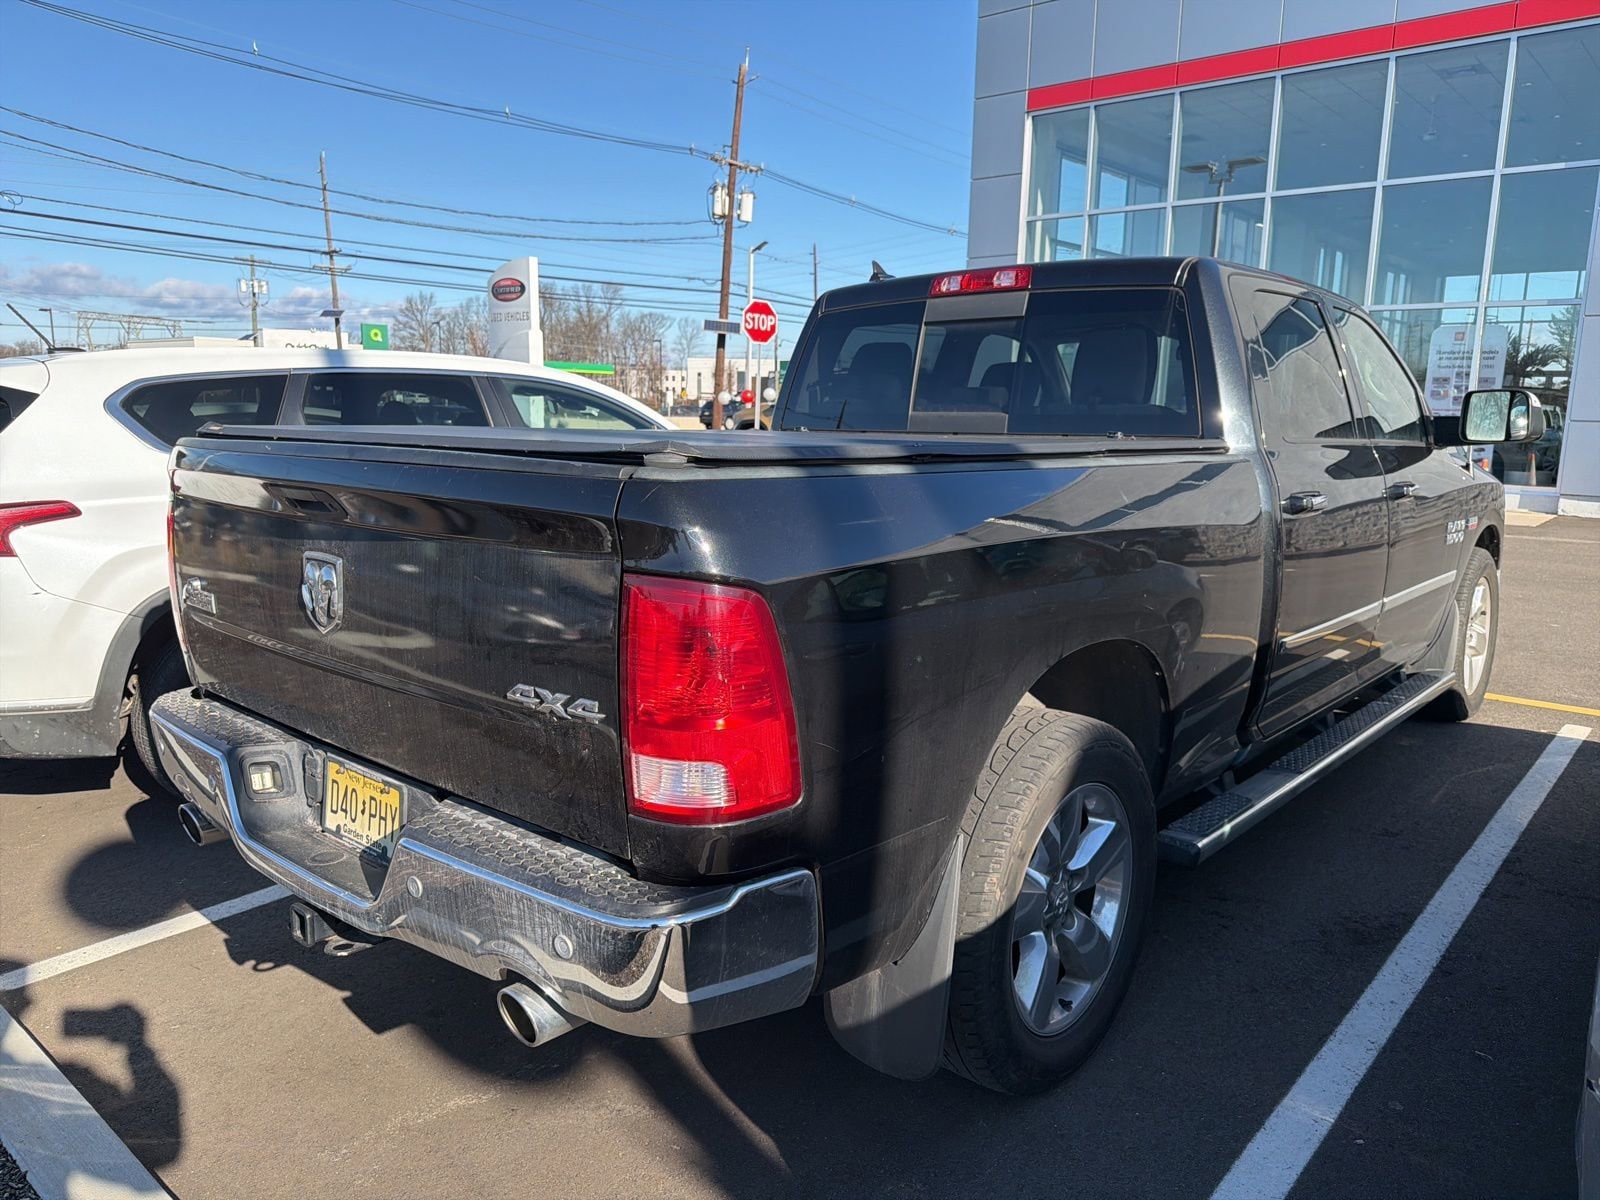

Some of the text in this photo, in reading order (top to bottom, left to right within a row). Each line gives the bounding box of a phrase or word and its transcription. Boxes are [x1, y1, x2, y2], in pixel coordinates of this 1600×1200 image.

[490, 311, 530, 322] USED VEHICLES
[745, 312, 775, 331] STOP
[345, 768, 361, 784] New
[361, 773, 384, 795] Jerse
[330, 778, 398, 843] D40 PHY
[342, 823, 383, 849] Garden State
